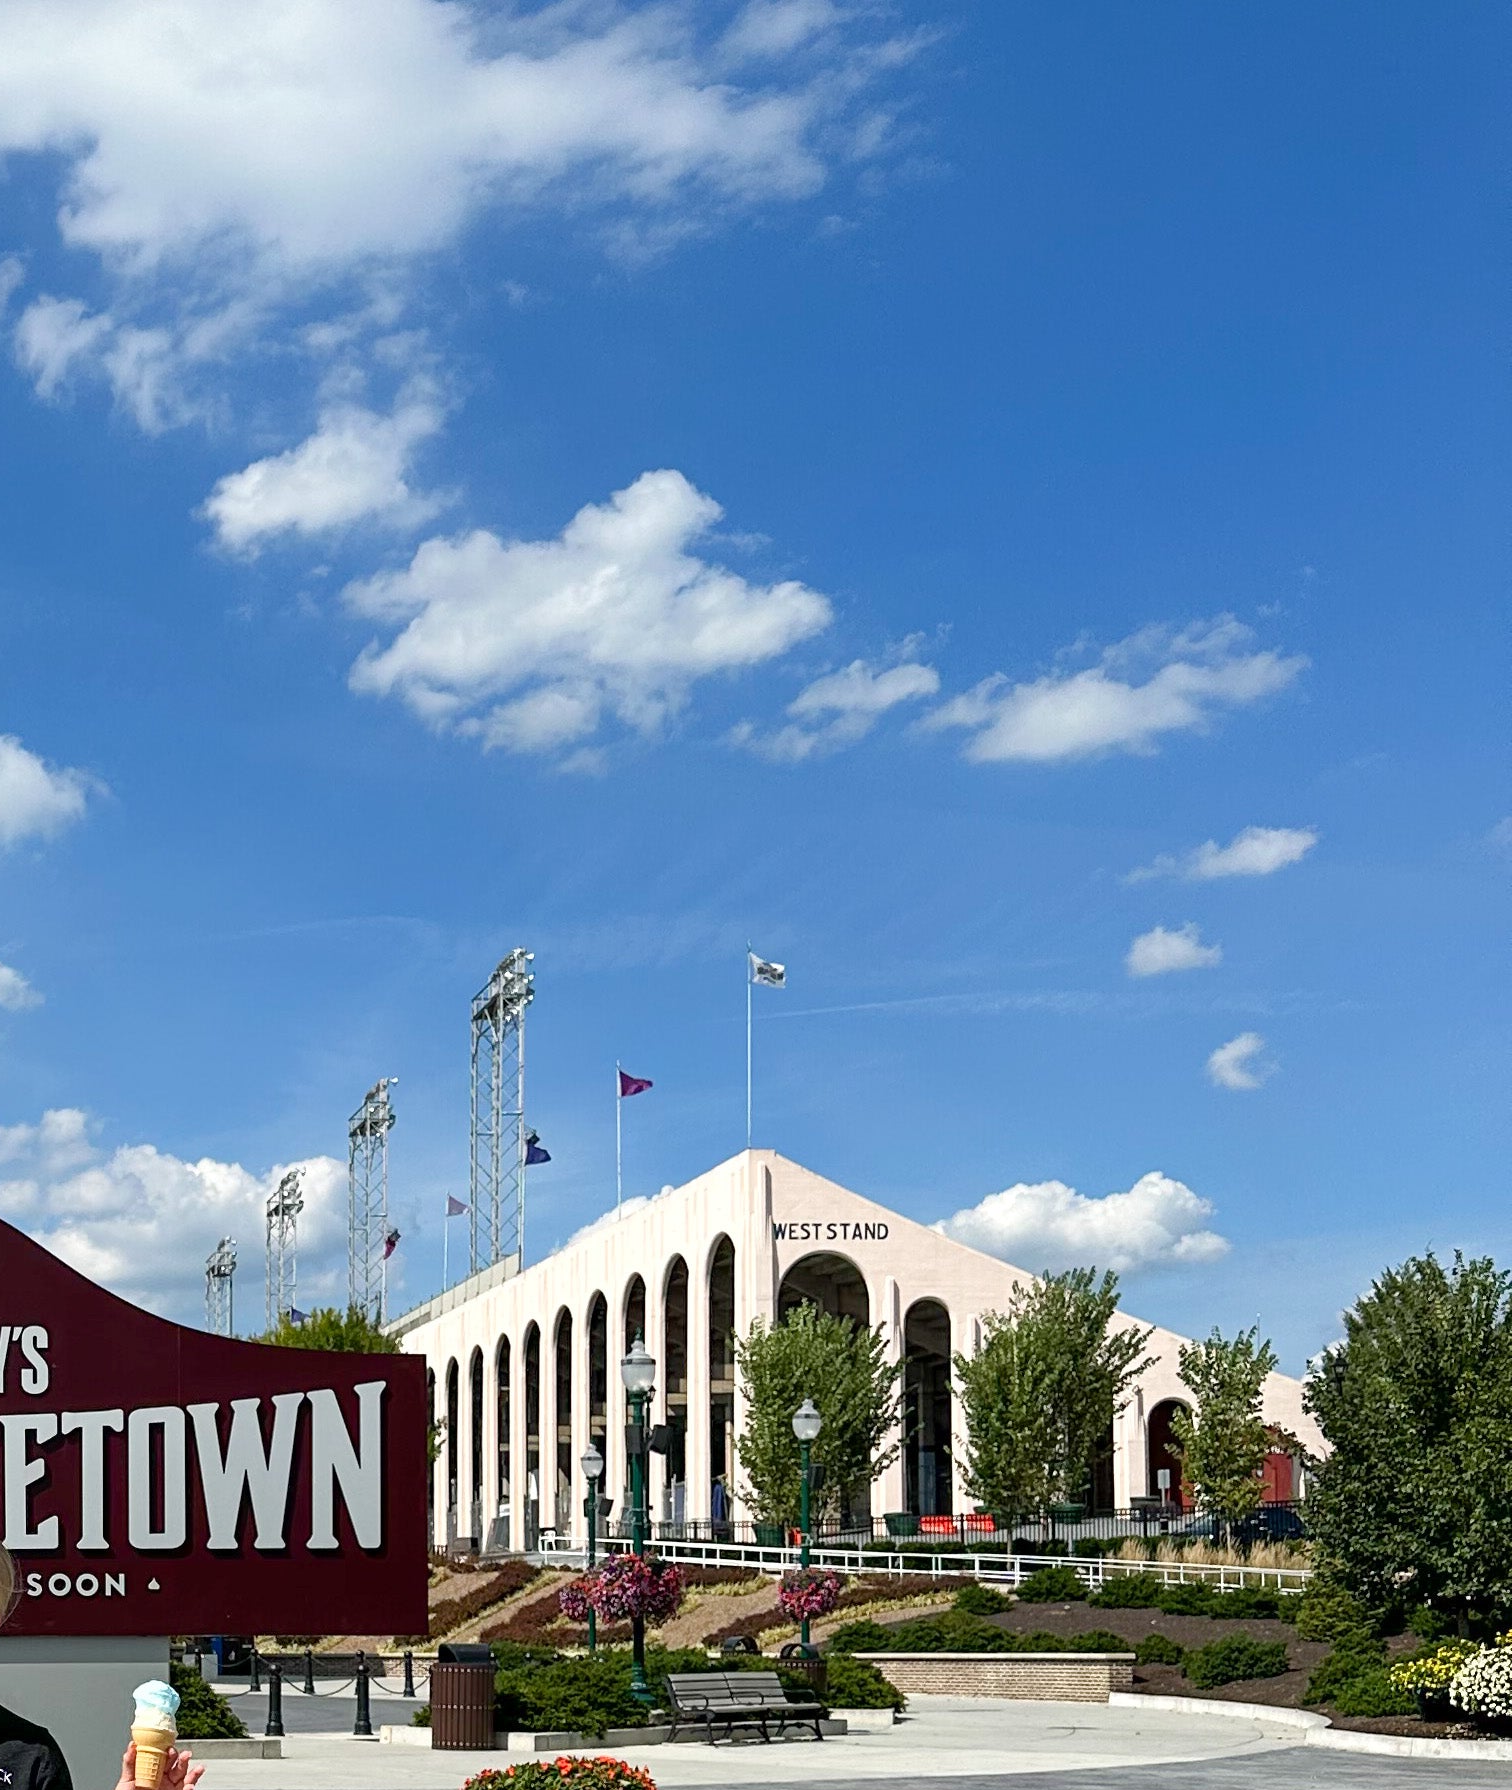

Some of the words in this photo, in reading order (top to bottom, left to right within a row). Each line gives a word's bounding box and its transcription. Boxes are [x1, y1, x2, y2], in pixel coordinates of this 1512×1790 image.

[772, 1223, 822, 1240] WEST
[826, 1223, 889, 1240] STAND
[26, 1573, 126, 1597] SOON
